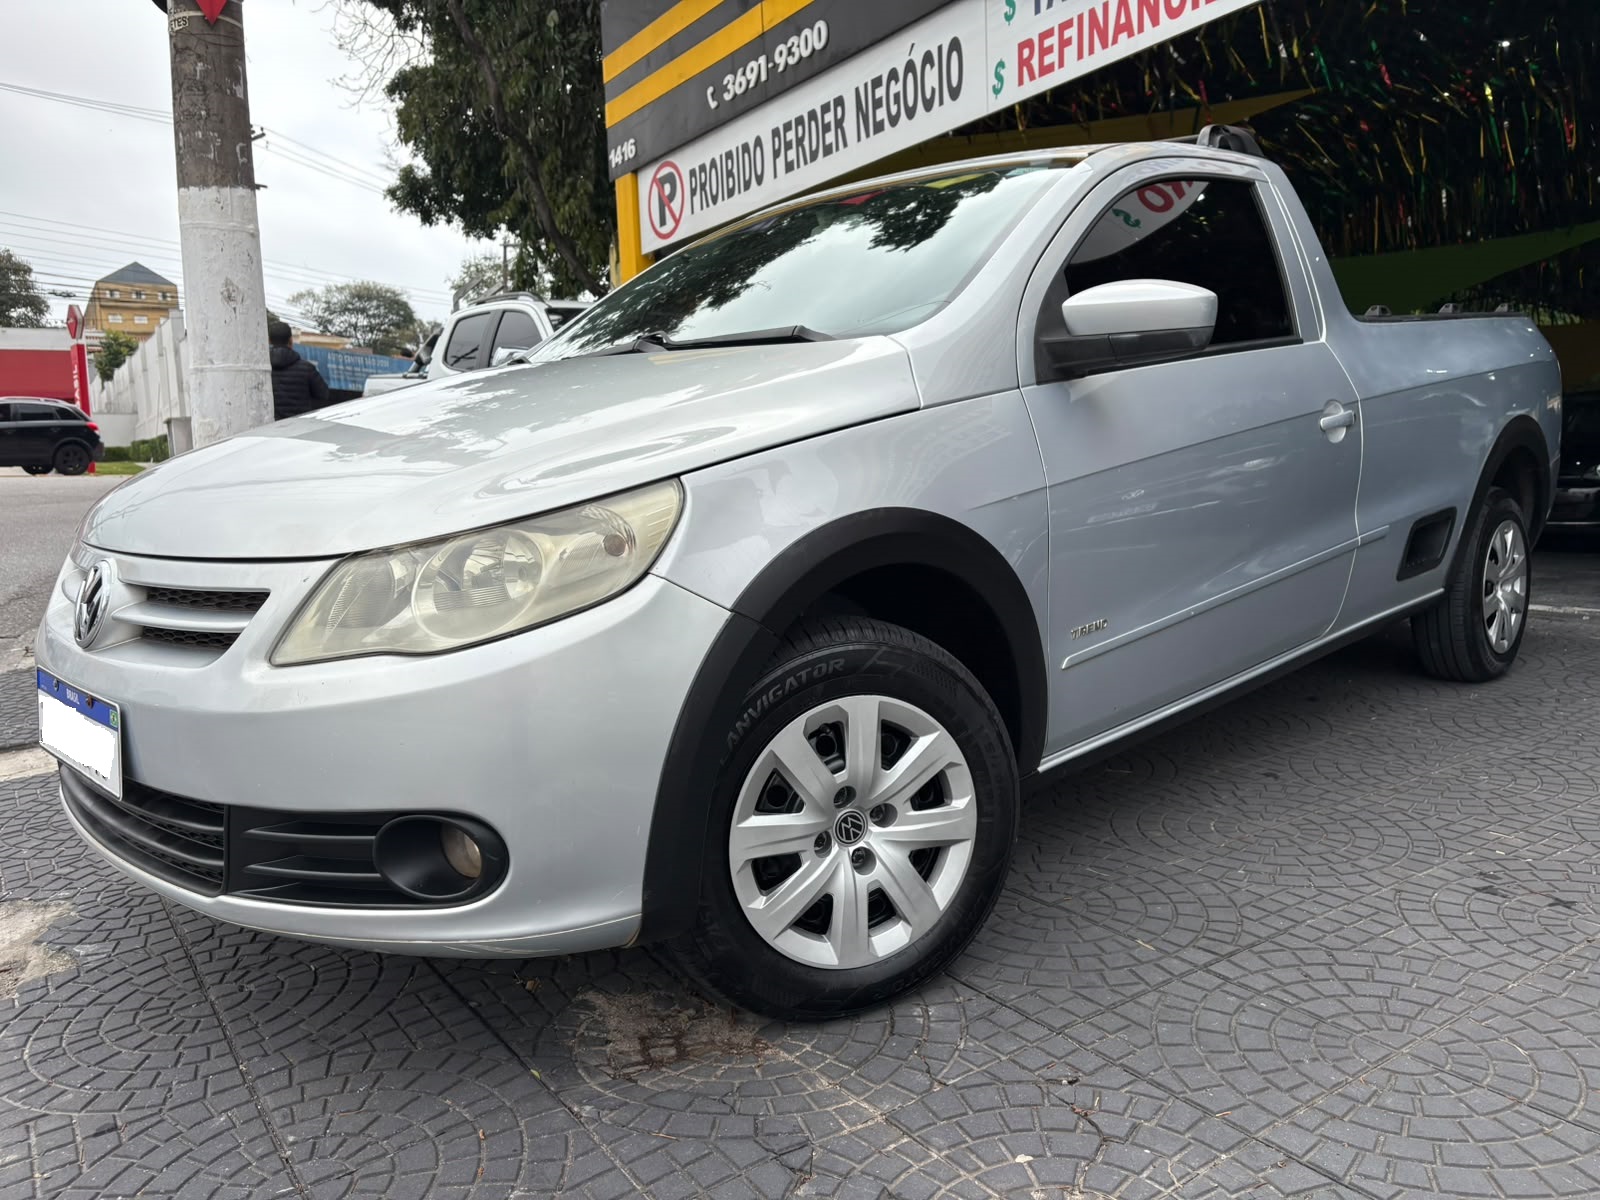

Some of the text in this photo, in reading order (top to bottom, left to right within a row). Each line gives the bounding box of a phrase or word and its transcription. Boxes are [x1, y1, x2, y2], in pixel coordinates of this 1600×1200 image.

[722, 19, 829, 101] 3691-9300
[1017, 0, 1216, 87] REFINAN
[609, 138, 636, 168] 1416
[689, 36, 963, 215] PROIBIDO PERDER NEGÓCIO
[1071, 619, 1107, 640] TREND
